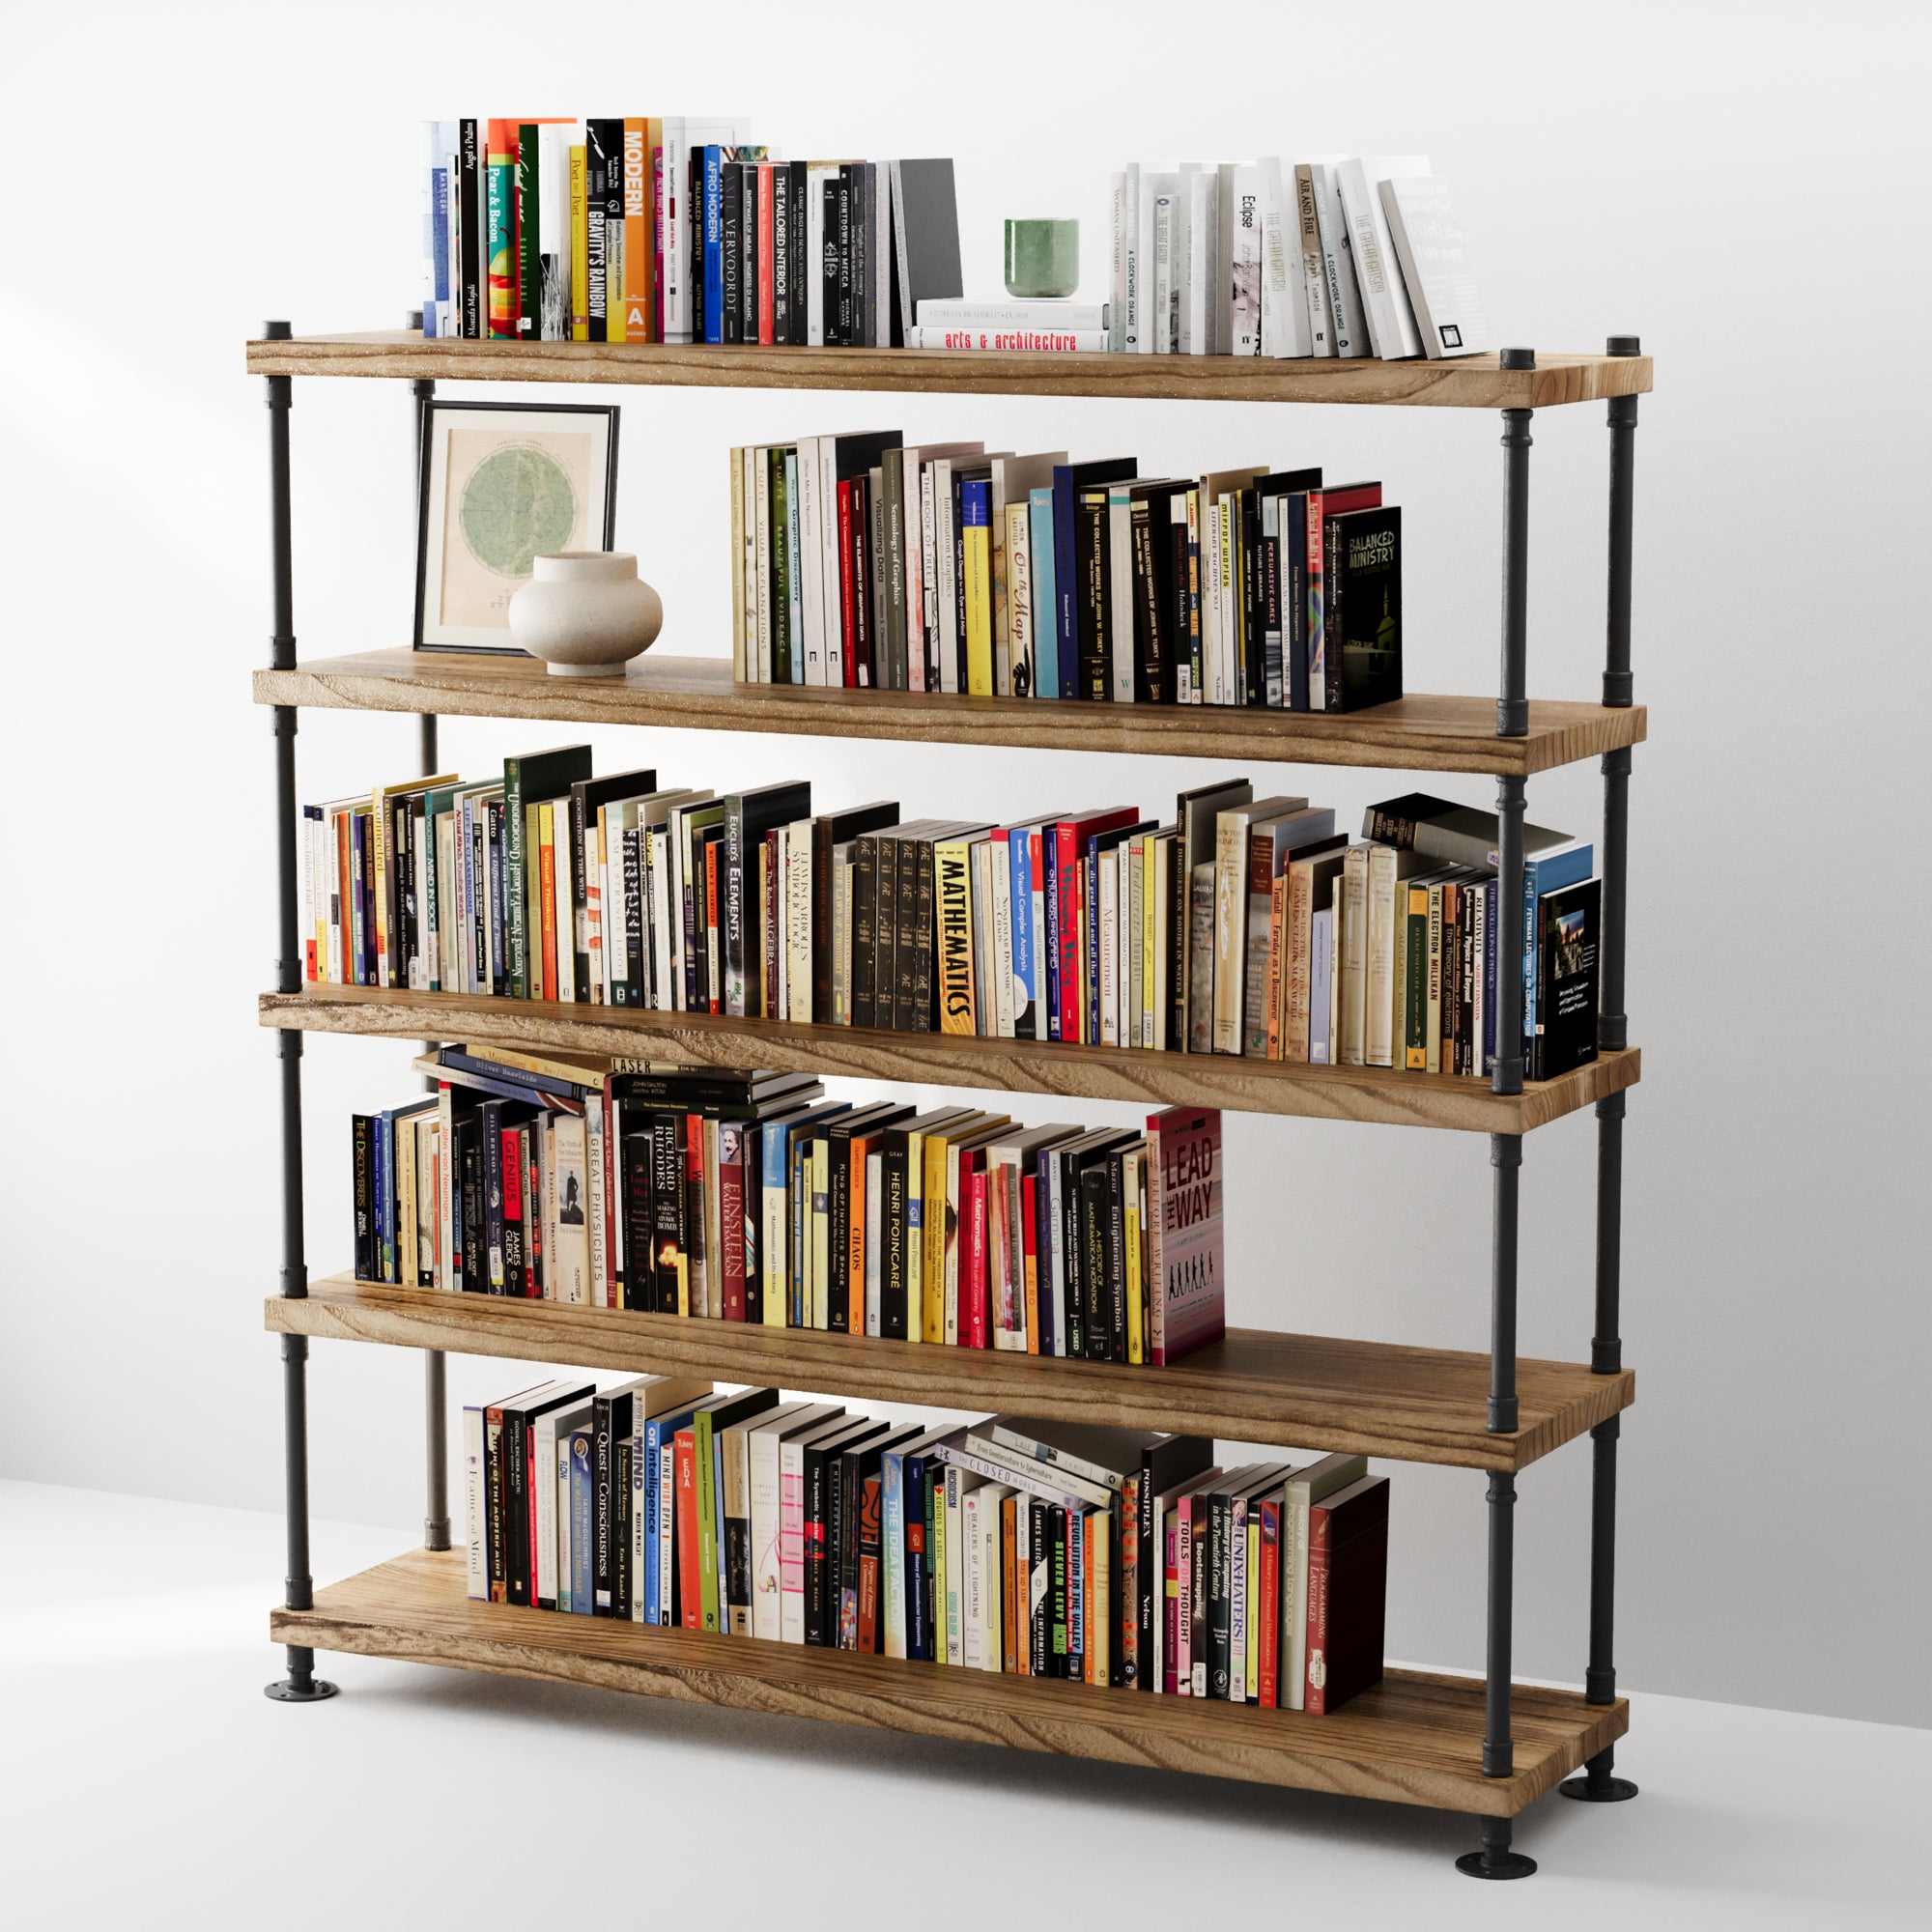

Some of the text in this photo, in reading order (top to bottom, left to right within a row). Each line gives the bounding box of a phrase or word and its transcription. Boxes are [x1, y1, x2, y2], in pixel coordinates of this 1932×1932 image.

[465, 122, 473, 144] Psalms
[624, 131, 643, 216] MODERN
[490, 167, 499, 243] Pear & Bacon
[708, 160, 717, 242] AFRO MODERN
[1240, 196, 1255, 227] Eclipse
[1299, 178, 1315, 235] AIR AND FIRE
[776, 176, 785, 295] THE TAILORED INTERIOR
[843, 247, 849, 256] TO
[588, 211, 605, 318] GRAVITY'S RAINBOW
[726, 218, 736, 313] VERVOORDT
[1328, 260, 1339, 302] CLOCKWORK
[1334, 304, 1344, 330] ORANGE
[946, 331, 1076, 351] arts & architecture
[875, 497, 885, 582] Visualizing Data
[890, 503, 901, 605] Semiology of Graphics
[925, 535, 932, 548] OF
[1349, 530, 1395, 554] BALANCED
[1349, 544, 1394, 569] MINISTRY
[1222, 548, 1230, 588] worlds
[1011, 552, 1028, 639] On the Map
[1178, 589, 1187, 627] Holodeck
[490, 809, 498, 838] Gatto
[577, 846, 583, 855] IN
[492, 859, 500, 896] Different
[729, 815, 741, 941] EUCLID'S ELEMENTS
[1273, 887, 1282, 914] Tyndall
[494, 920, 501, 928] of
[544, 886, 553, 931] Thinking
[1017, 898, 1026, 934] Complex
[1176, 899, 1183, 911] ON
[941, 859, 971, 1017] MATHEMATICS
[1018, 938, 1028, 971] Analysis
[1102, 908, 1113, 996] Measurement
[1176, 950, 1182, 960] IN
[1272, 924, 1281, 955] Faraday
[1272, 958, 1279, 967] as
[1430, 891, 1439, 1000] THE ELECTRON MILLIKAN
[1525, 978, 1533, 987] ON
[1524, 989, 1533, 1037] COMPUTATION
[612, 1058, 651, 1074] LASER
[356, 1119, 367, 1206] THE DISCOVERERS
[505, 1140, 517, 1202] GENIUS
[655, 1125, 665, 1190] RHODES
[665, 1126, 675, 1190] RICHARD
[1166, 1136, 1213, 1192] LEAD
[591, 1137, 603, 1281] GREAT PHYSICISTS
[723, 1181, 731, 1222] WALTER
[1175, 1180, 1213, 1230] WAY
[729, 1183, 743, 1278] EINSTEIN
[852, 1227, 861, 1270] CHAOS
[891, 1172, 902, 1289] HENRI POINCARÉ
[1112, 1205, 1122, 1281] Enlightening
[1113, 1284, 1122, 1333] Symbols
[598, 1431, 609, 1471] Quest
[647, 1427, 657, 1534] on intelligence
[948, 1468, 957, 1507] MICROCOSM
[599, 1482, 610, 1577] Consciousness
[1034, 1534, 1042, 1566] GLEICK
[888, 1498, 901, 1635] THE IDEA FACTORY
[1054, 1540, 1065, 1619] STEVEN LEVY
[1193, 1541, 1204, 1618] Bootstrapping
[1232, 1533, 1245, 1638] UNIX-HATERS
[1053, 1623, 1067, 1653] HACKERS
